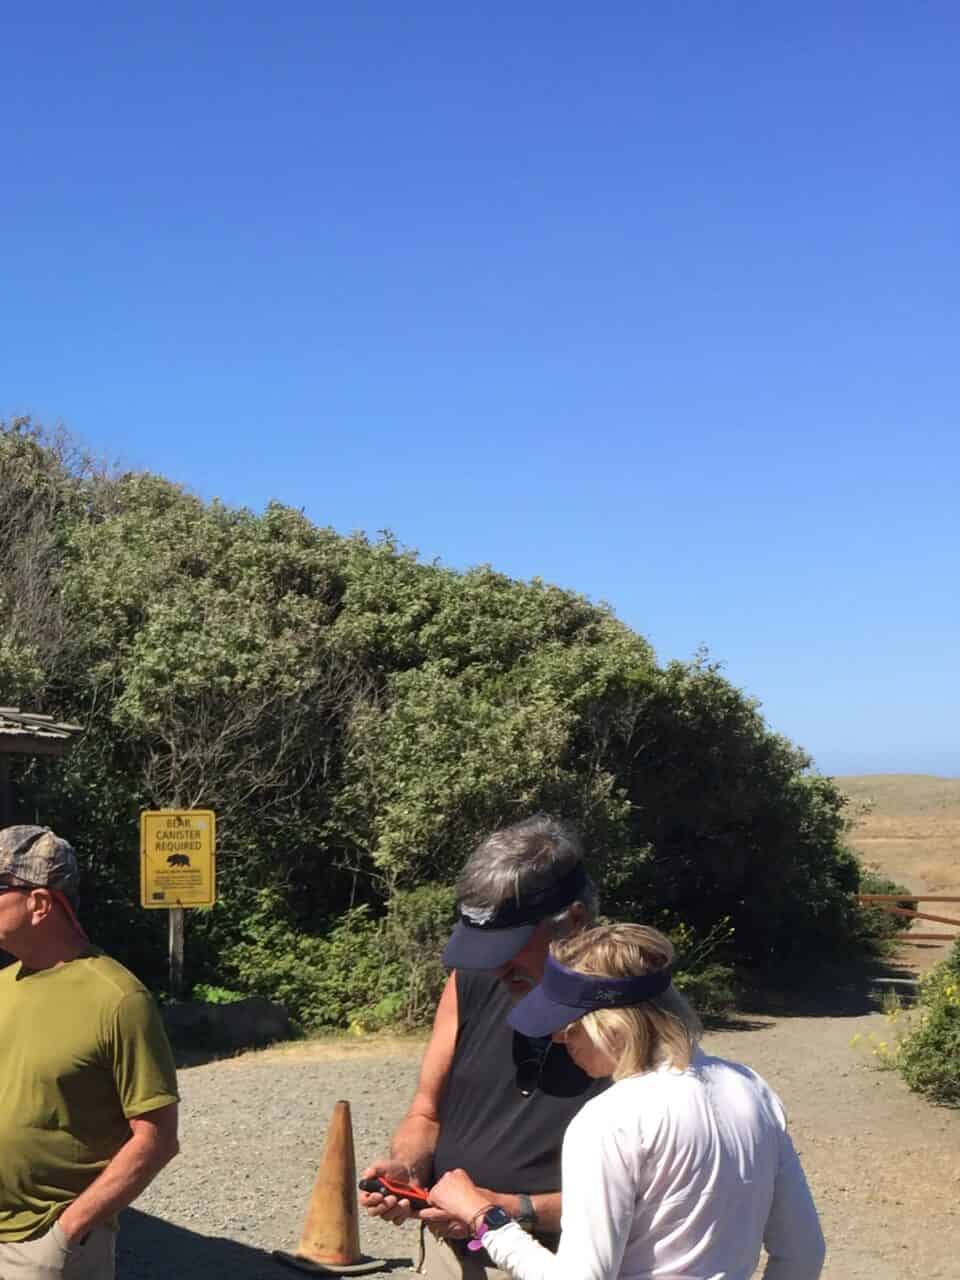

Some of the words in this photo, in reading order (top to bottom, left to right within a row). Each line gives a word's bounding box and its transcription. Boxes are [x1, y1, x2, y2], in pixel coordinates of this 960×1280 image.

[167, 818, 191, 828] BEAR
[155, 830, 201, 840] CANISTER
[155, 840, 202, 851] REQUIRED
